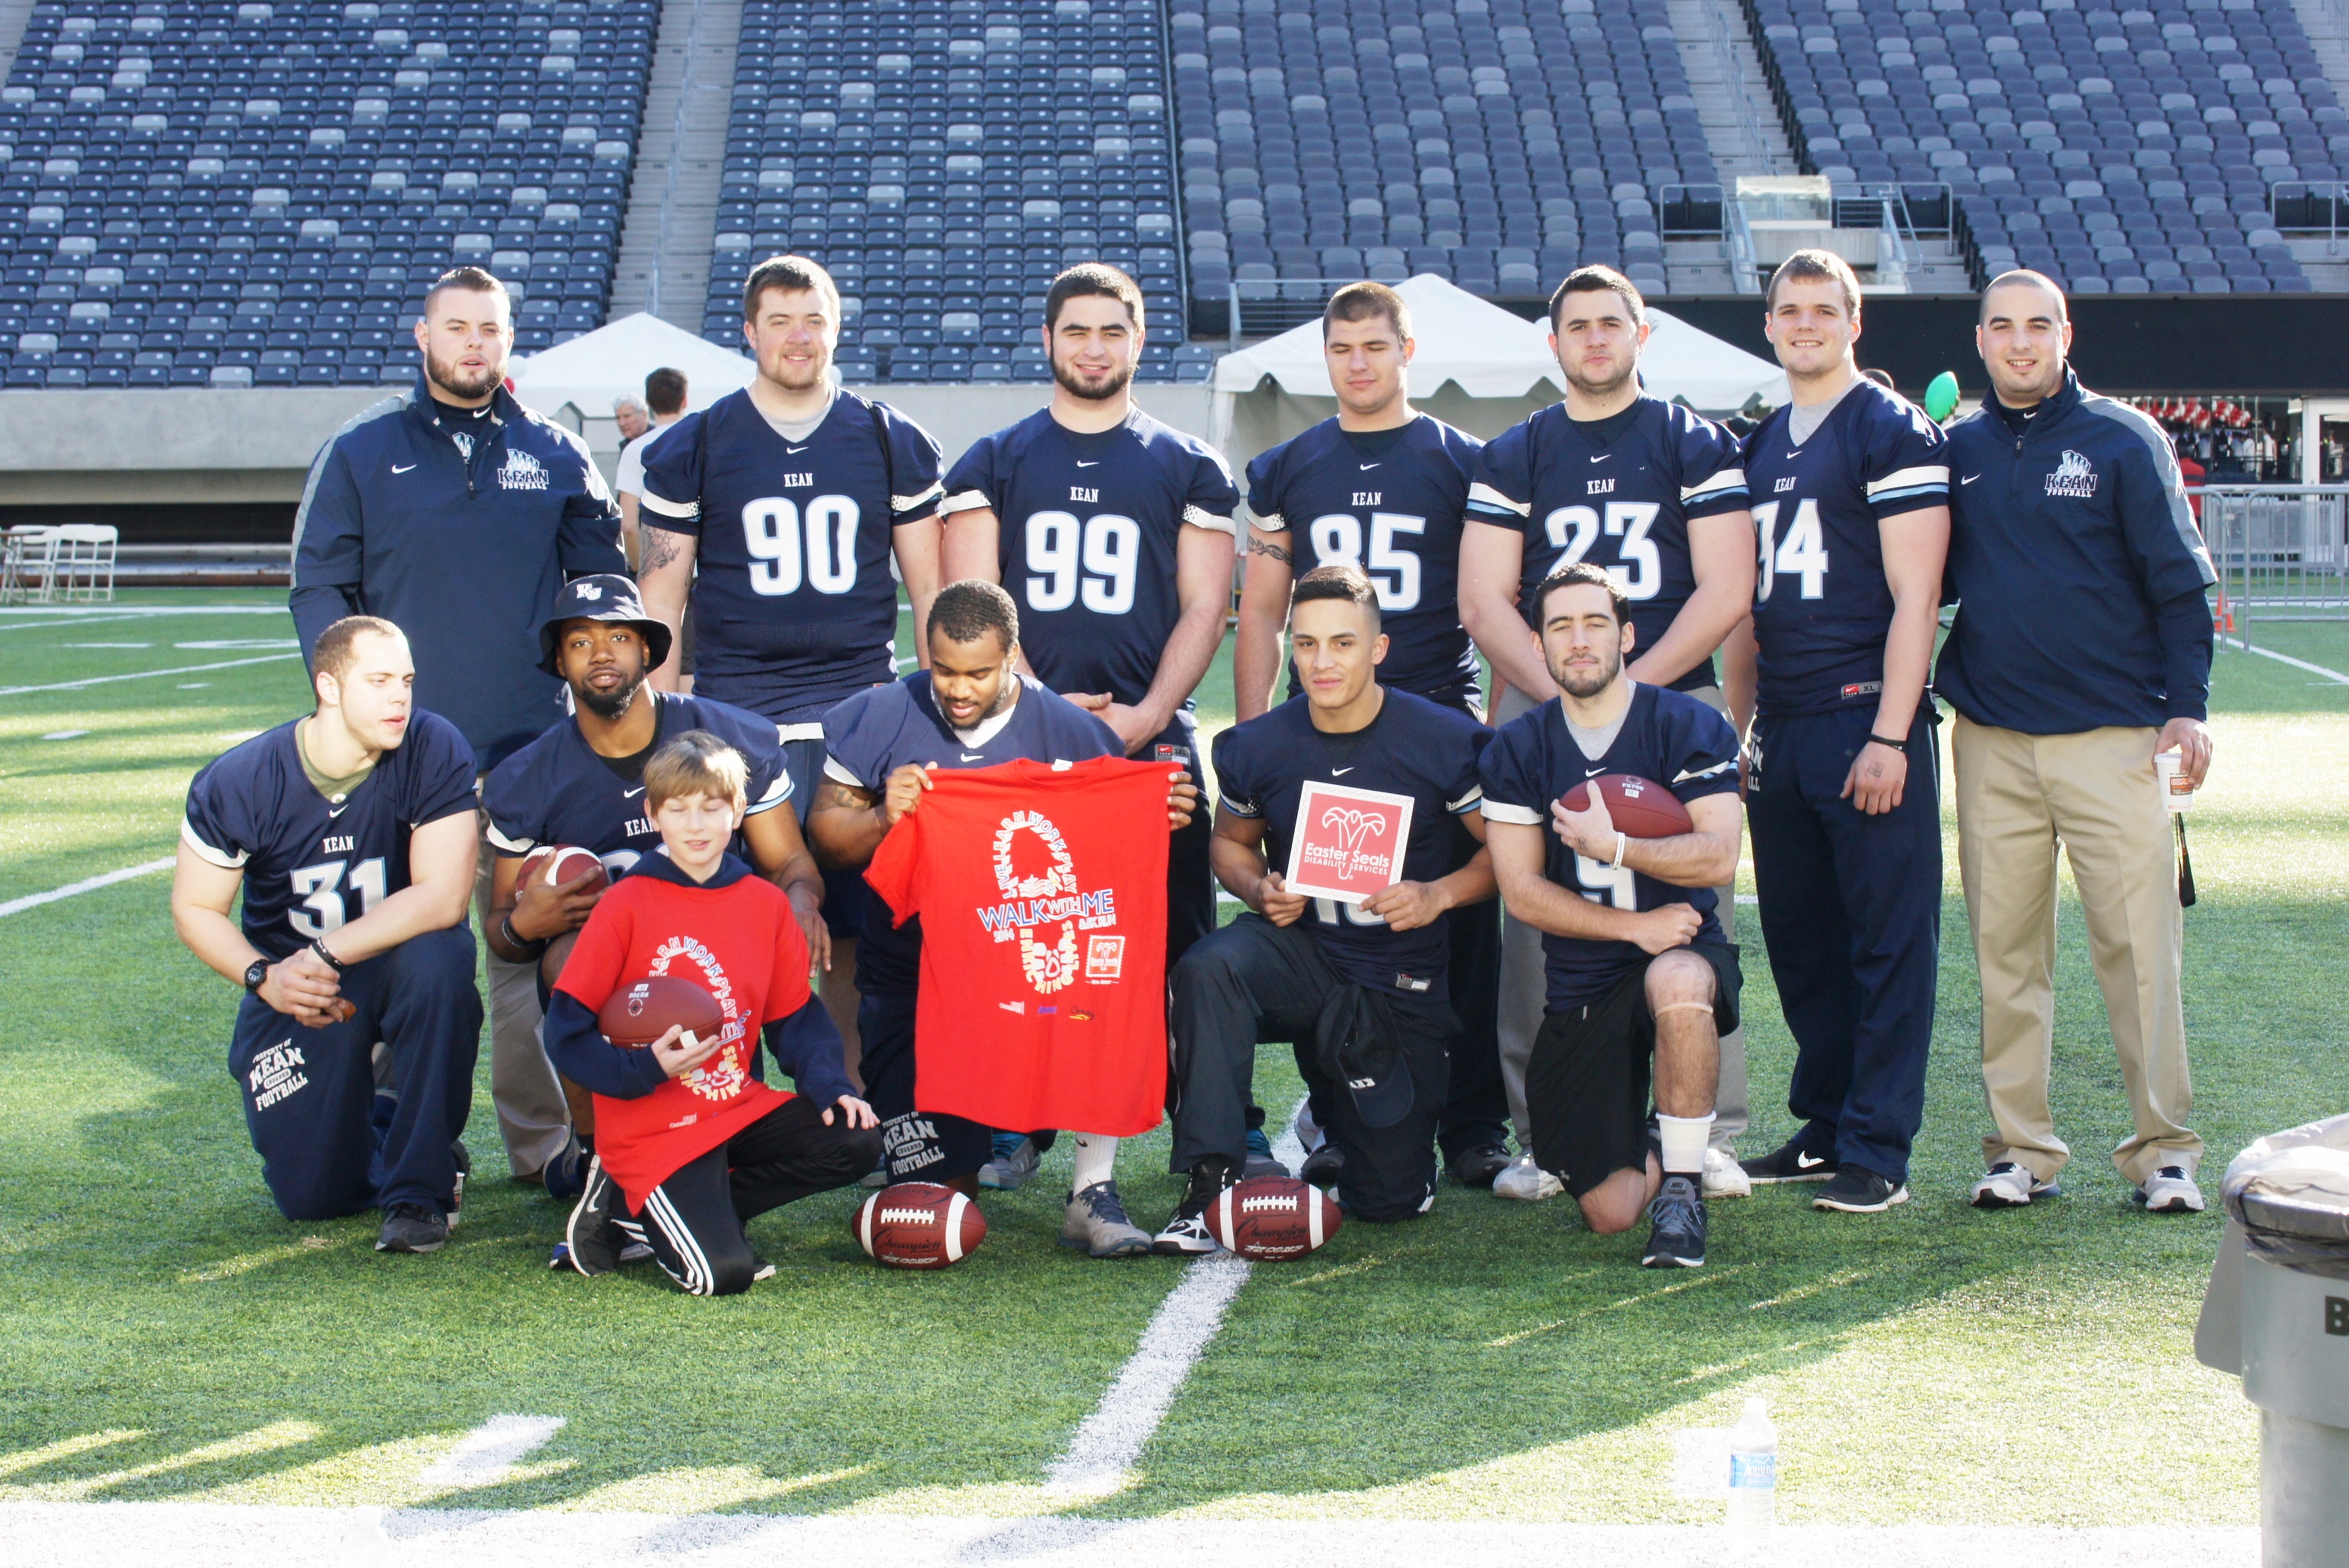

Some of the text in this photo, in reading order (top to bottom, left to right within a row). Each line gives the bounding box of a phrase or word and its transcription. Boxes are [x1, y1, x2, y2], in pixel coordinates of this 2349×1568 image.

[498, 468, 549, 485] KEAN
[502, 482, 547, 490] FOOTBALL
[784, 473, 813, 487] KEAN
[1587, 478, 1615, 494] KEAN
[1774, 476, 1796, 493] KEAN
[2044, 473, 2098, 491] KEAN
[1070, 487, 1099, 502] KEAN
[1352, 492, 1382, 506] KEAN
[2046, 489, 2092, 498] FOOTBALL
[742, 495, 860, 596] 90
[1545, 502, 1661, 600] 23
[1025, 511, 1140, 614] 99
[1310, 512, 1427, 611] 85
[577, 583, 602, 601] KU
[323, 835, 354, 854] KEAN
[1028, 810, 1067, 851] WORK
[1056, 852, 1078, 894] PLAY
[1305, 842, 1390, 868] Easter Seals
[1304, 856, 1388, 876] DISABILITY SERVICES
[288, 856, 387, 939] 31
[976, 888, 1115, 932] WALK WITH ME
[1097, 913, 1116, 928] RUN
[1019, 928, 1075, 994] ENRICHING
[649, 935, 738, 1019] EARN WORK PLAY
[284, 1038, 292, 1047] OF
[249, 1047, 306, 1093] KEAN
[255, 1072, 309, 1112] FOOTBALL
[882, 1113, 910, 1128] PROPERTY
[883, 1120, 939, 1156] KEAN
[891, 1146, 945, 1176] FOOTBALL
[1235, 1217, 1308, 1240] Champion
[873, 1229, 941, 1253] Champion
